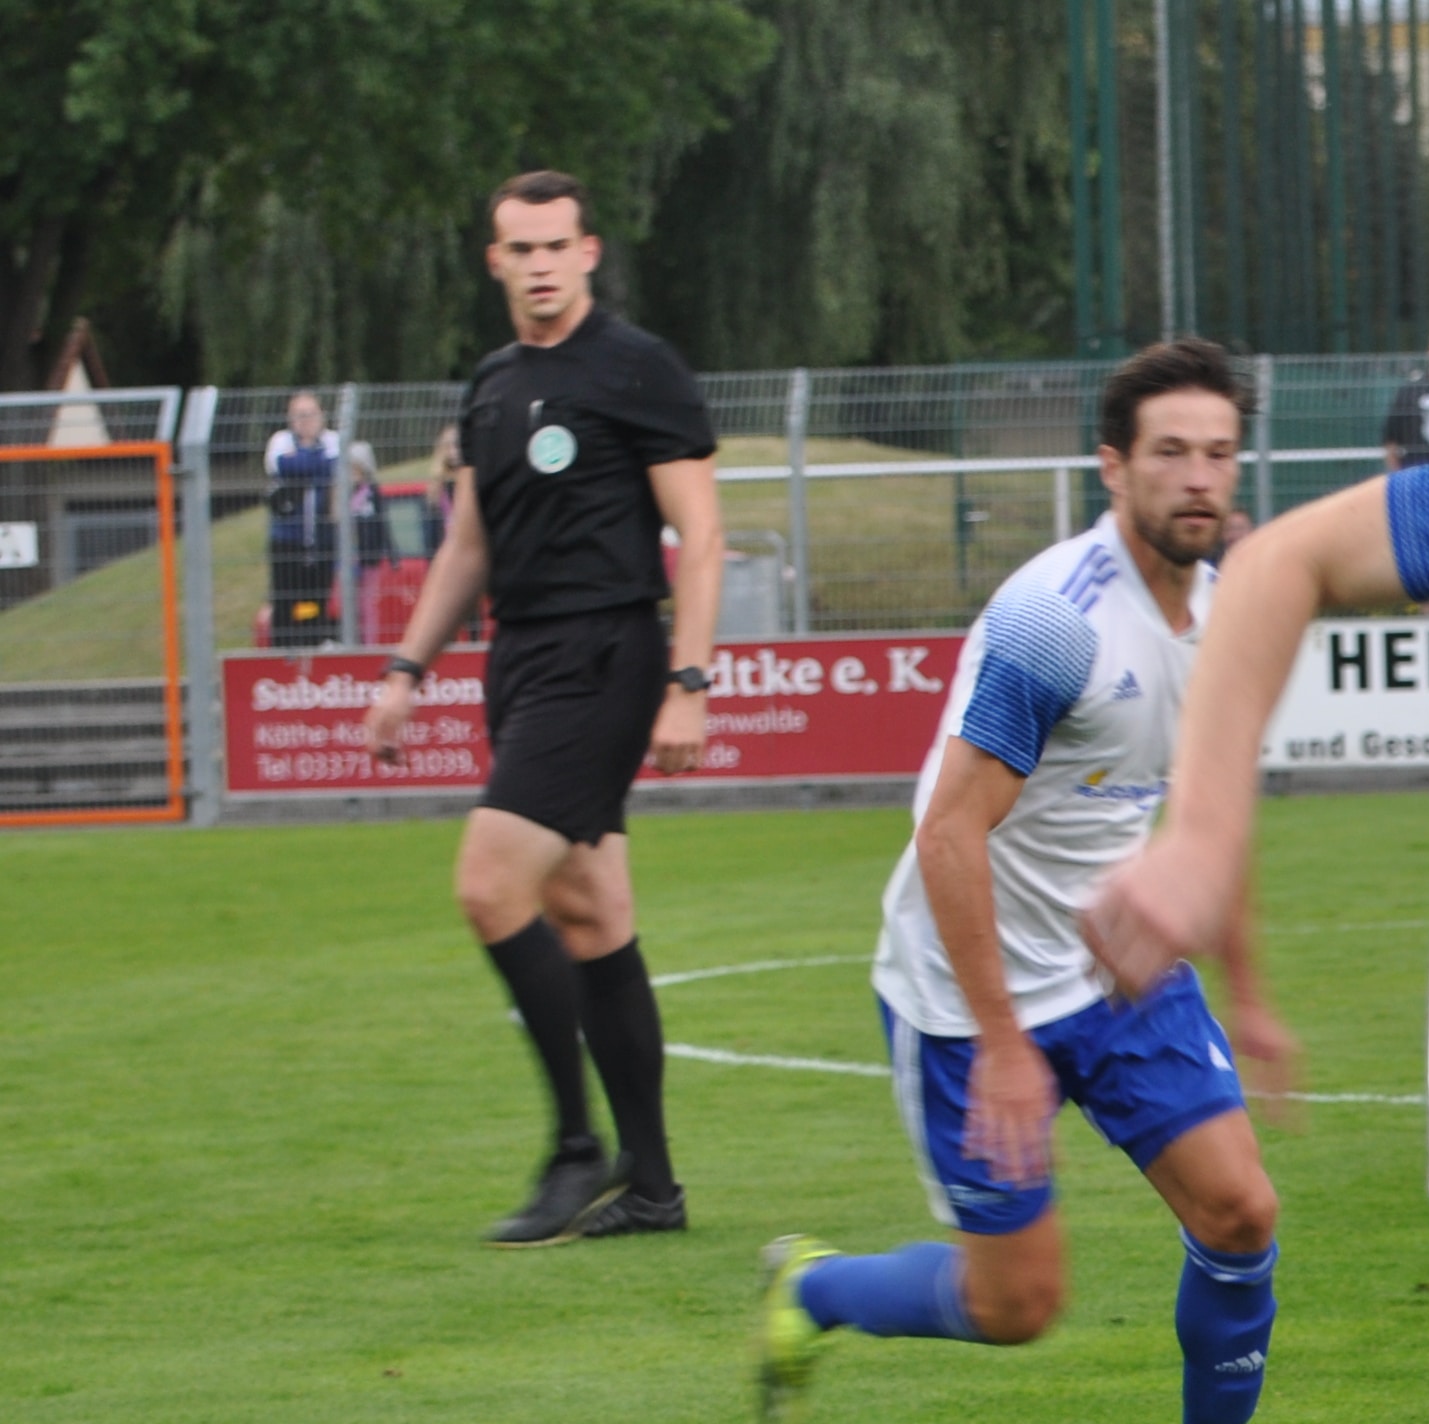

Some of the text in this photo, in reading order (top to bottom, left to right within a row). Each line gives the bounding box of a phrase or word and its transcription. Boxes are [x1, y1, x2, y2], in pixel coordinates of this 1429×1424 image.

[831, 656, 878, 695] e.
[888, 646, 943, 693] K.
[253, 671, 485, 711] Subdireion
[255, 716, 479, 748] Käthe-Koitz-Str.
[1287, 733, 1345, 758] und
